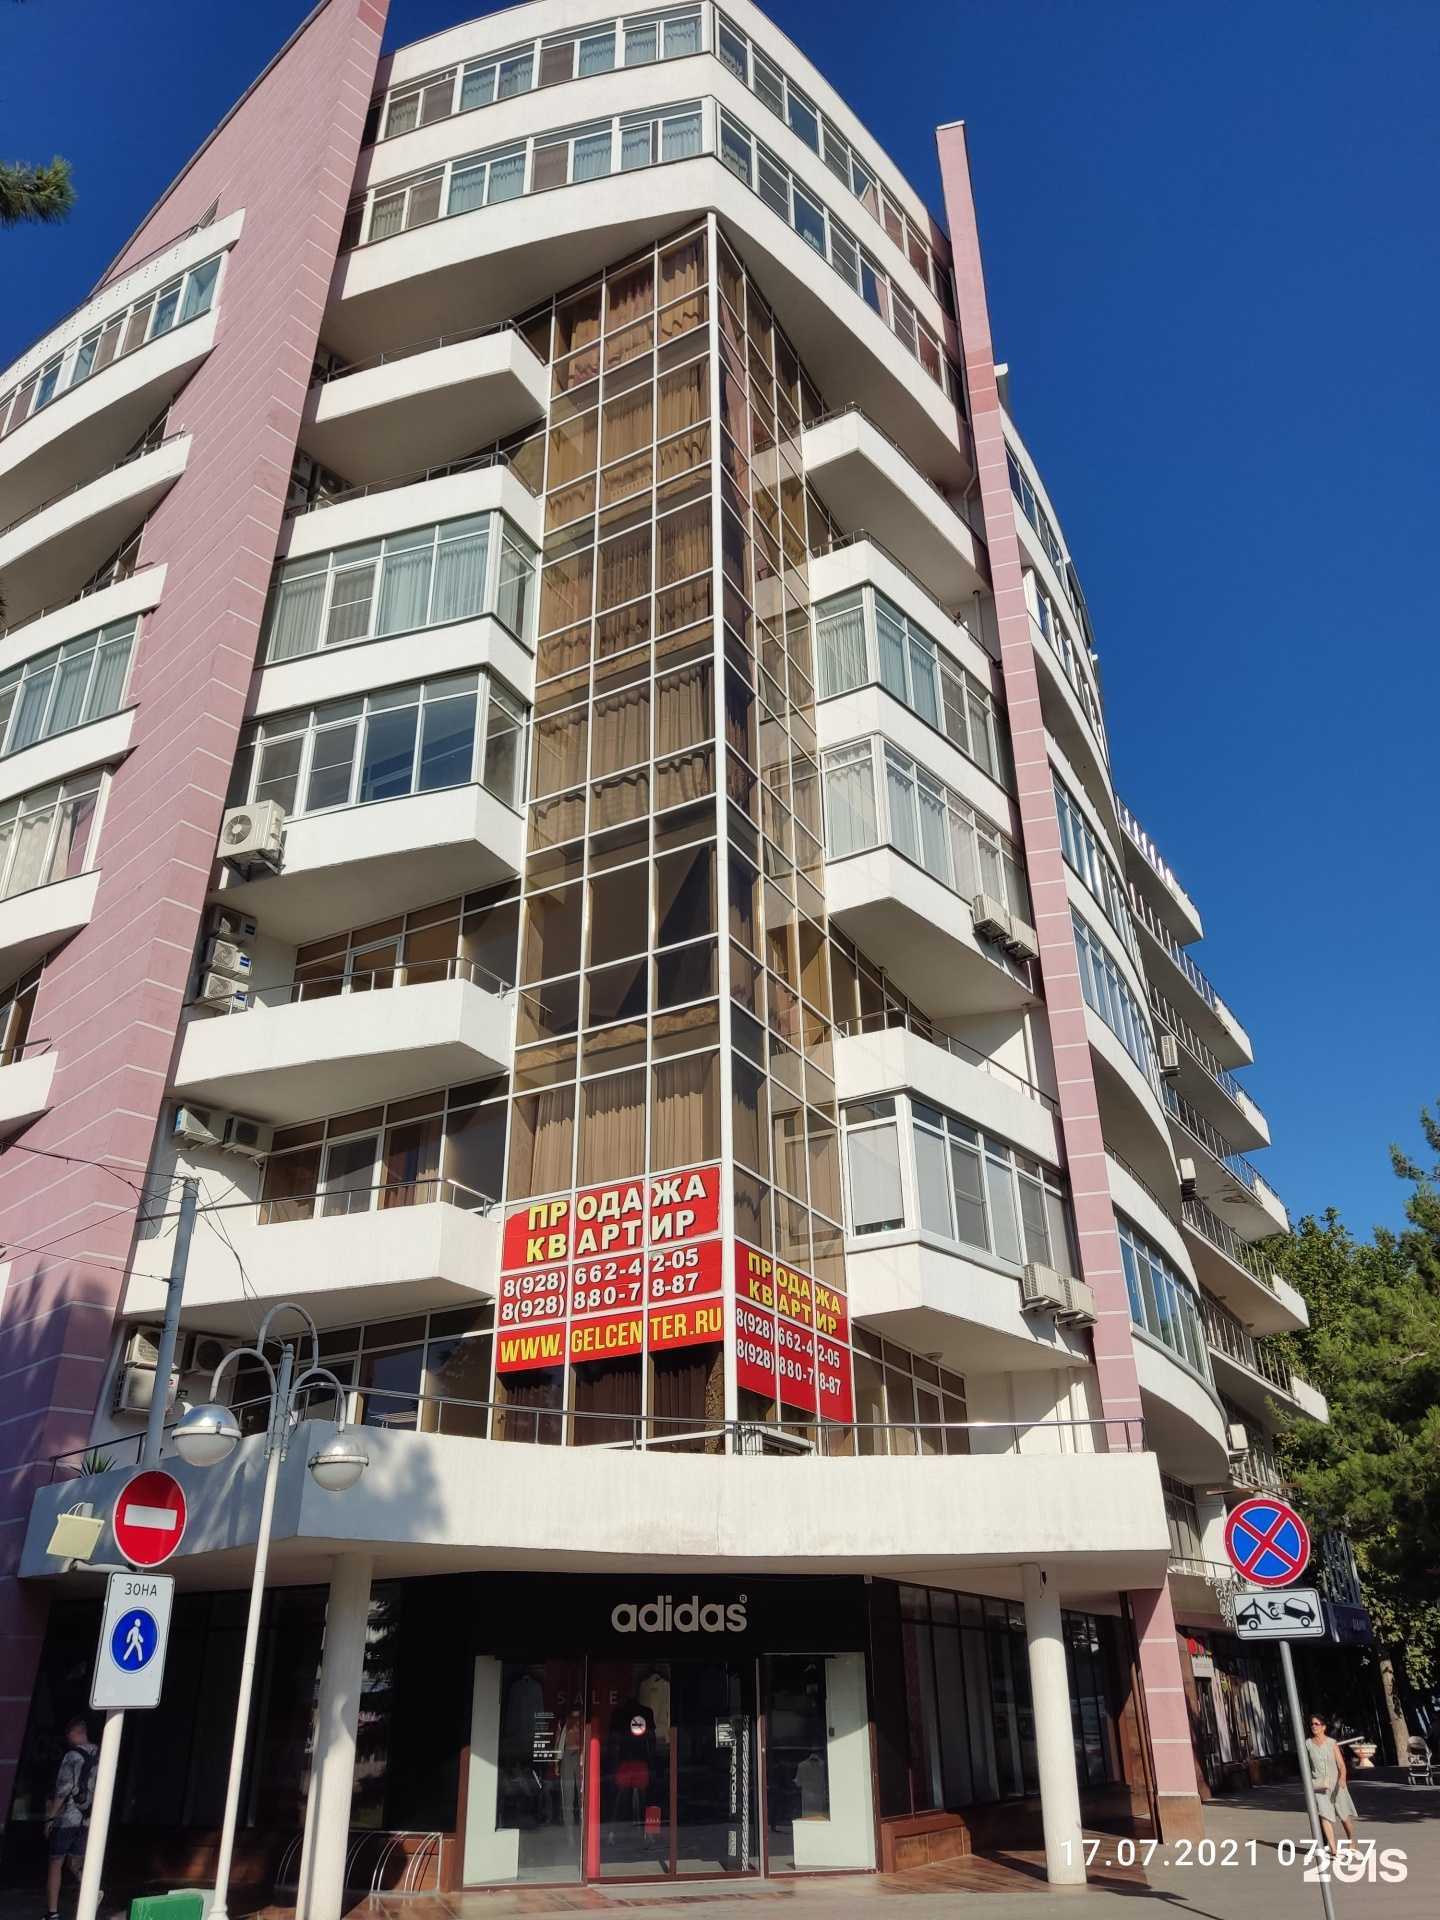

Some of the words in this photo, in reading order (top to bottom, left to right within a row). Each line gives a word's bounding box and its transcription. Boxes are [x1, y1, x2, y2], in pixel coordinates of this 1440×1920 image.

[528, 1174, 707, 1231] ПРОДАЖА
[526, 1209, 696, 1263] КВАРТИР
[503, 1272, 566, 1299] 8(928)
[748, 1252, 841, 1314] ПРОДАЖА
[502, 1295, 565, 1322] 8(928)
[748, 1278, 837, 1334] КВАРТИР
[736, 1308, 773, 1344] 8(928)
[737, 1338, 774, 1374] 8(928)
[124, 1582, 157, 1597] ЗОНА
